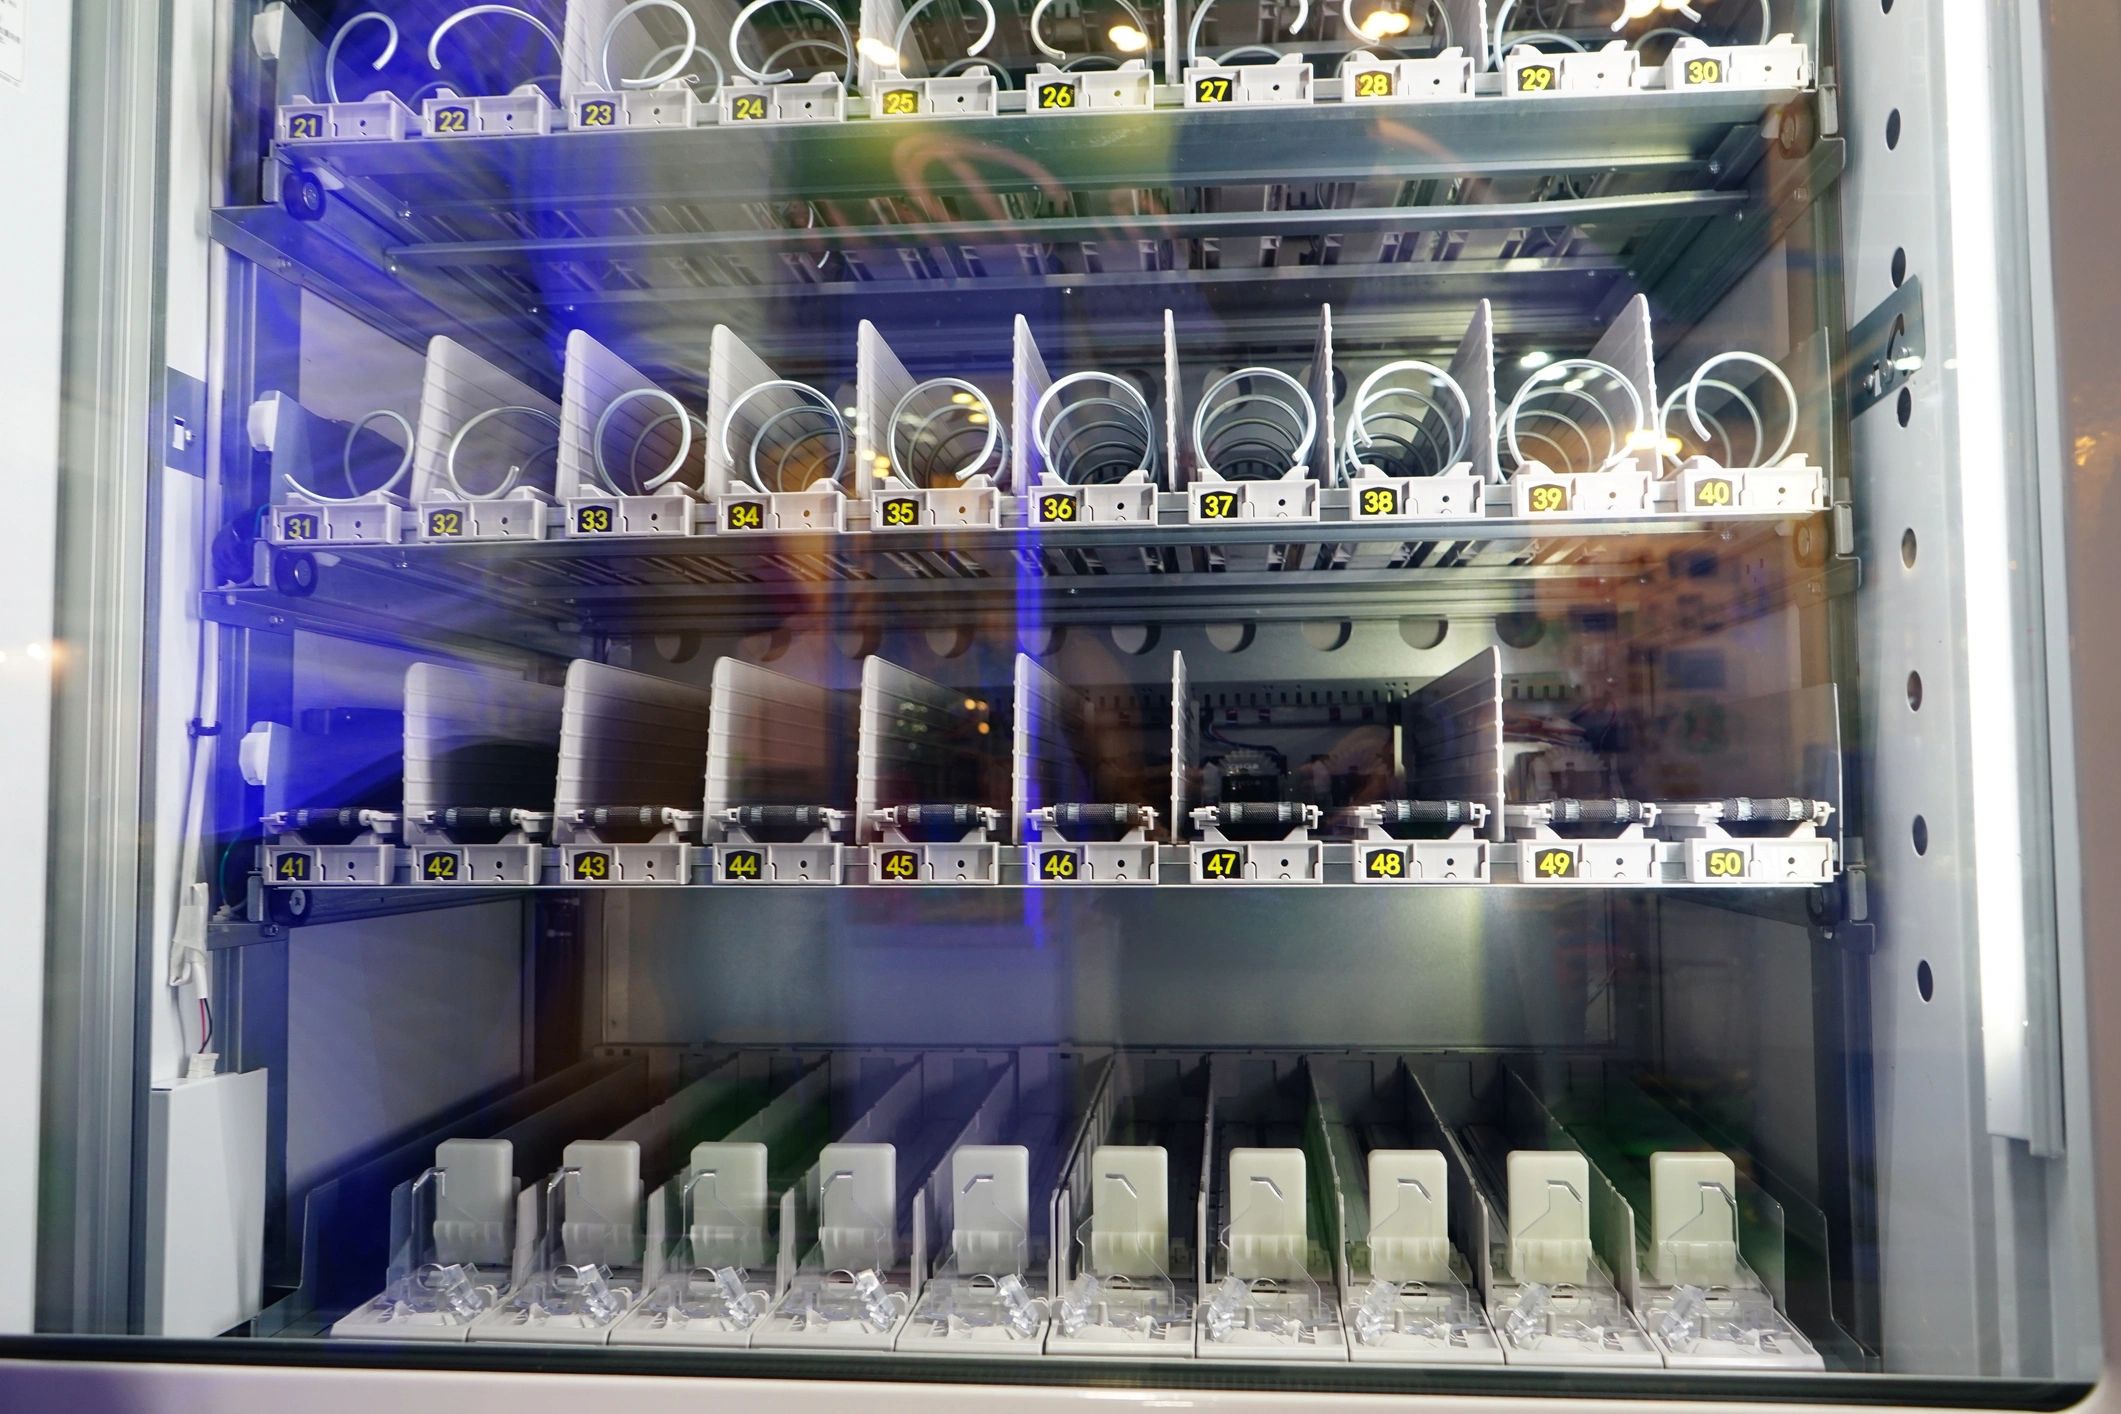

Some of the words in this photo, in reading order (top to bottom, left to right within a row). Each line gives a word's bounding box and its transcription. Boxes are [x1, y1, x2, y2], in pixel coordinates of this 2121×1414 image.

[1522, 69, 1550, 90] 29
[1689, 62, 1718, 82] 30
[1200, 81, 1227, 102] 27
[1360, 75, 1388, 95] 28
[888, 94, 914, 113] 25
[1043, 86, 1071, 107] 26
[586, 106, 612, 124] 23
[736, 99, 763, 118] 24
[294, 118, 316, 136] 21
[439, 111, 464, 130] 22
[1364, 492, 1393, 512] 38
[1533, 489, 1561, 510] 39
[1699, 483, 1729, 503] 40
[886, 503, 914, 523] 35
[1044, 498, 1072, 519] 36
[1205, 496, 1233, 516] 37
[432, 514, 458, 533] 32
[582, 510, 608, 530] 33
[732, 507, 759, 526] 34
[288, 519, 310, 538] 31
[281, 858, 302, 876] 41
[428, 857, 454, 876] 42
[578, 857, 605, 877] 43
[729, 856, 757, 875] 44
[886, 856, 913, 876] 45
[1044, 854, 1073, 875] 46
[1207, 854, 1236, 874] 47
[1371, 854, 1400, 874] 48
[1540, 853, 1569, 873] 49
[1710, 853, 1741, 874] 50
